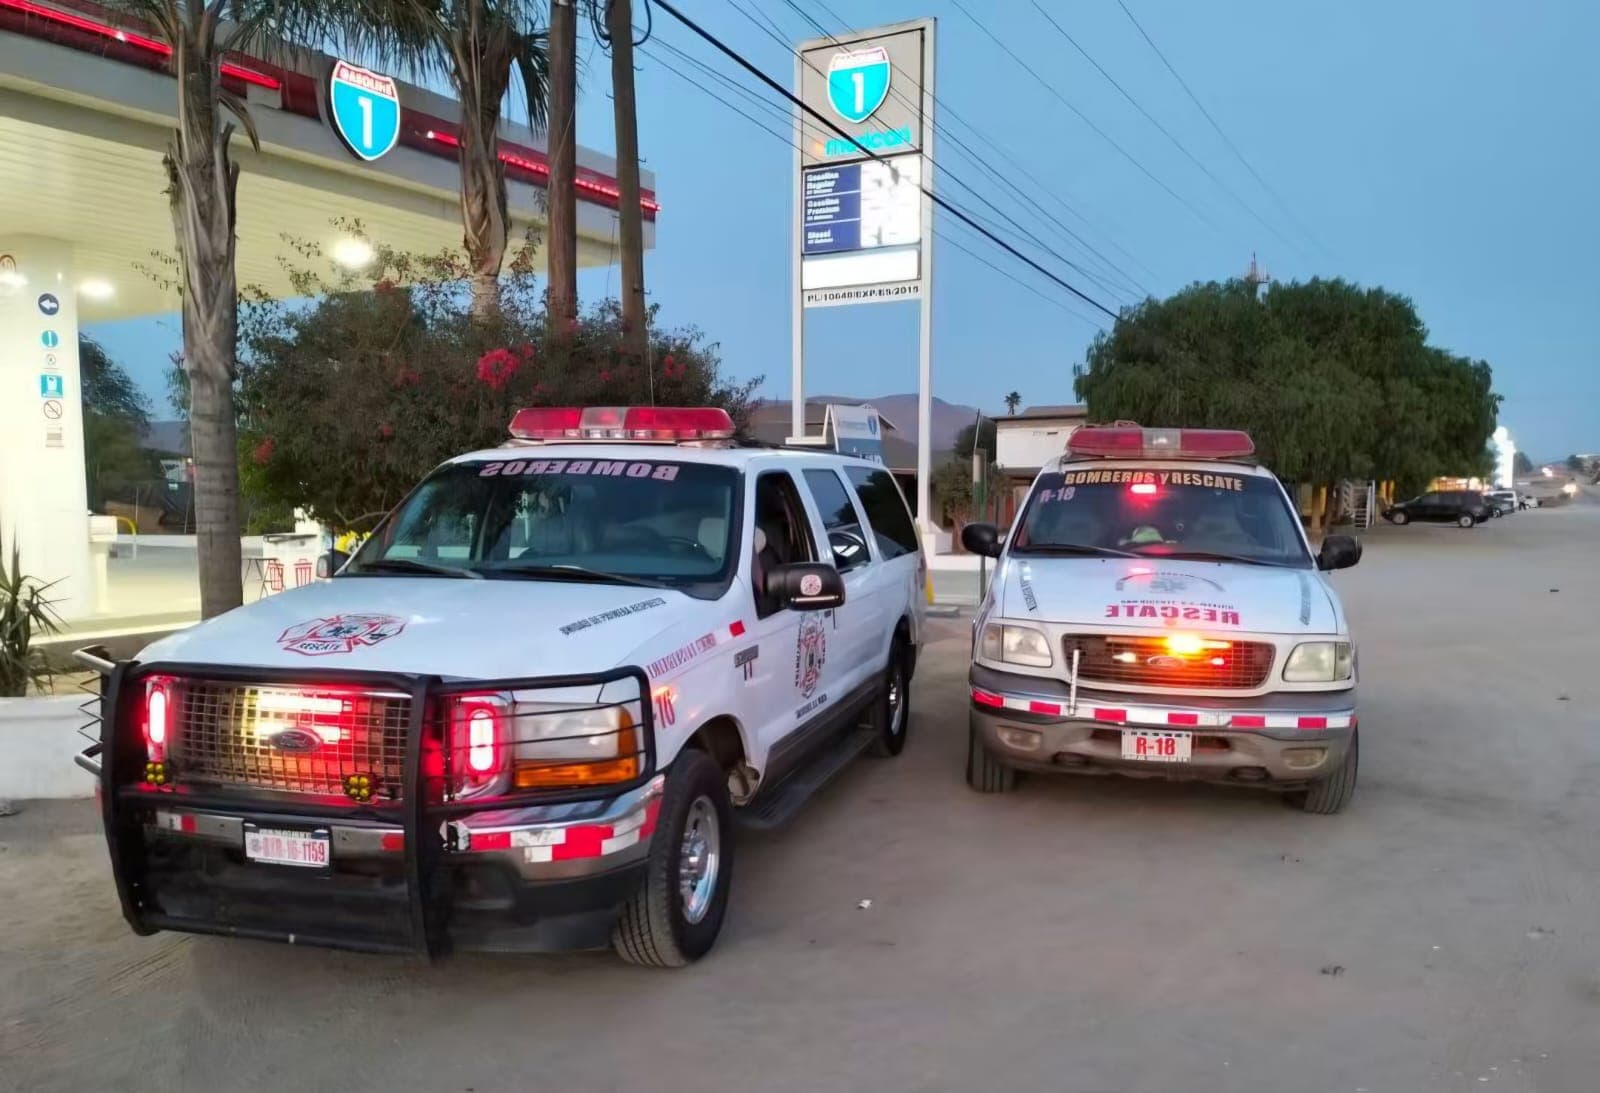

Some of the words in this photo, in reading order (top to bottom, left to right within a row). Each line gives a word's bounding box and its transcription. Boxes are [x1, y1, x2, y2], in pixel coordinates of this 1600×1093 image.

[852, 72, 864, 113] 1
[358, 95, 373, 149] 1
[1064, 471, 1156, 485] BOMBEROS
[1171, 473, 1243, 491] RESCATE
[1041, 487, 1076, 502] R-18
[299, 641, 341, 651] RESCATE
[1136, 736, 1176, 756] R-18
